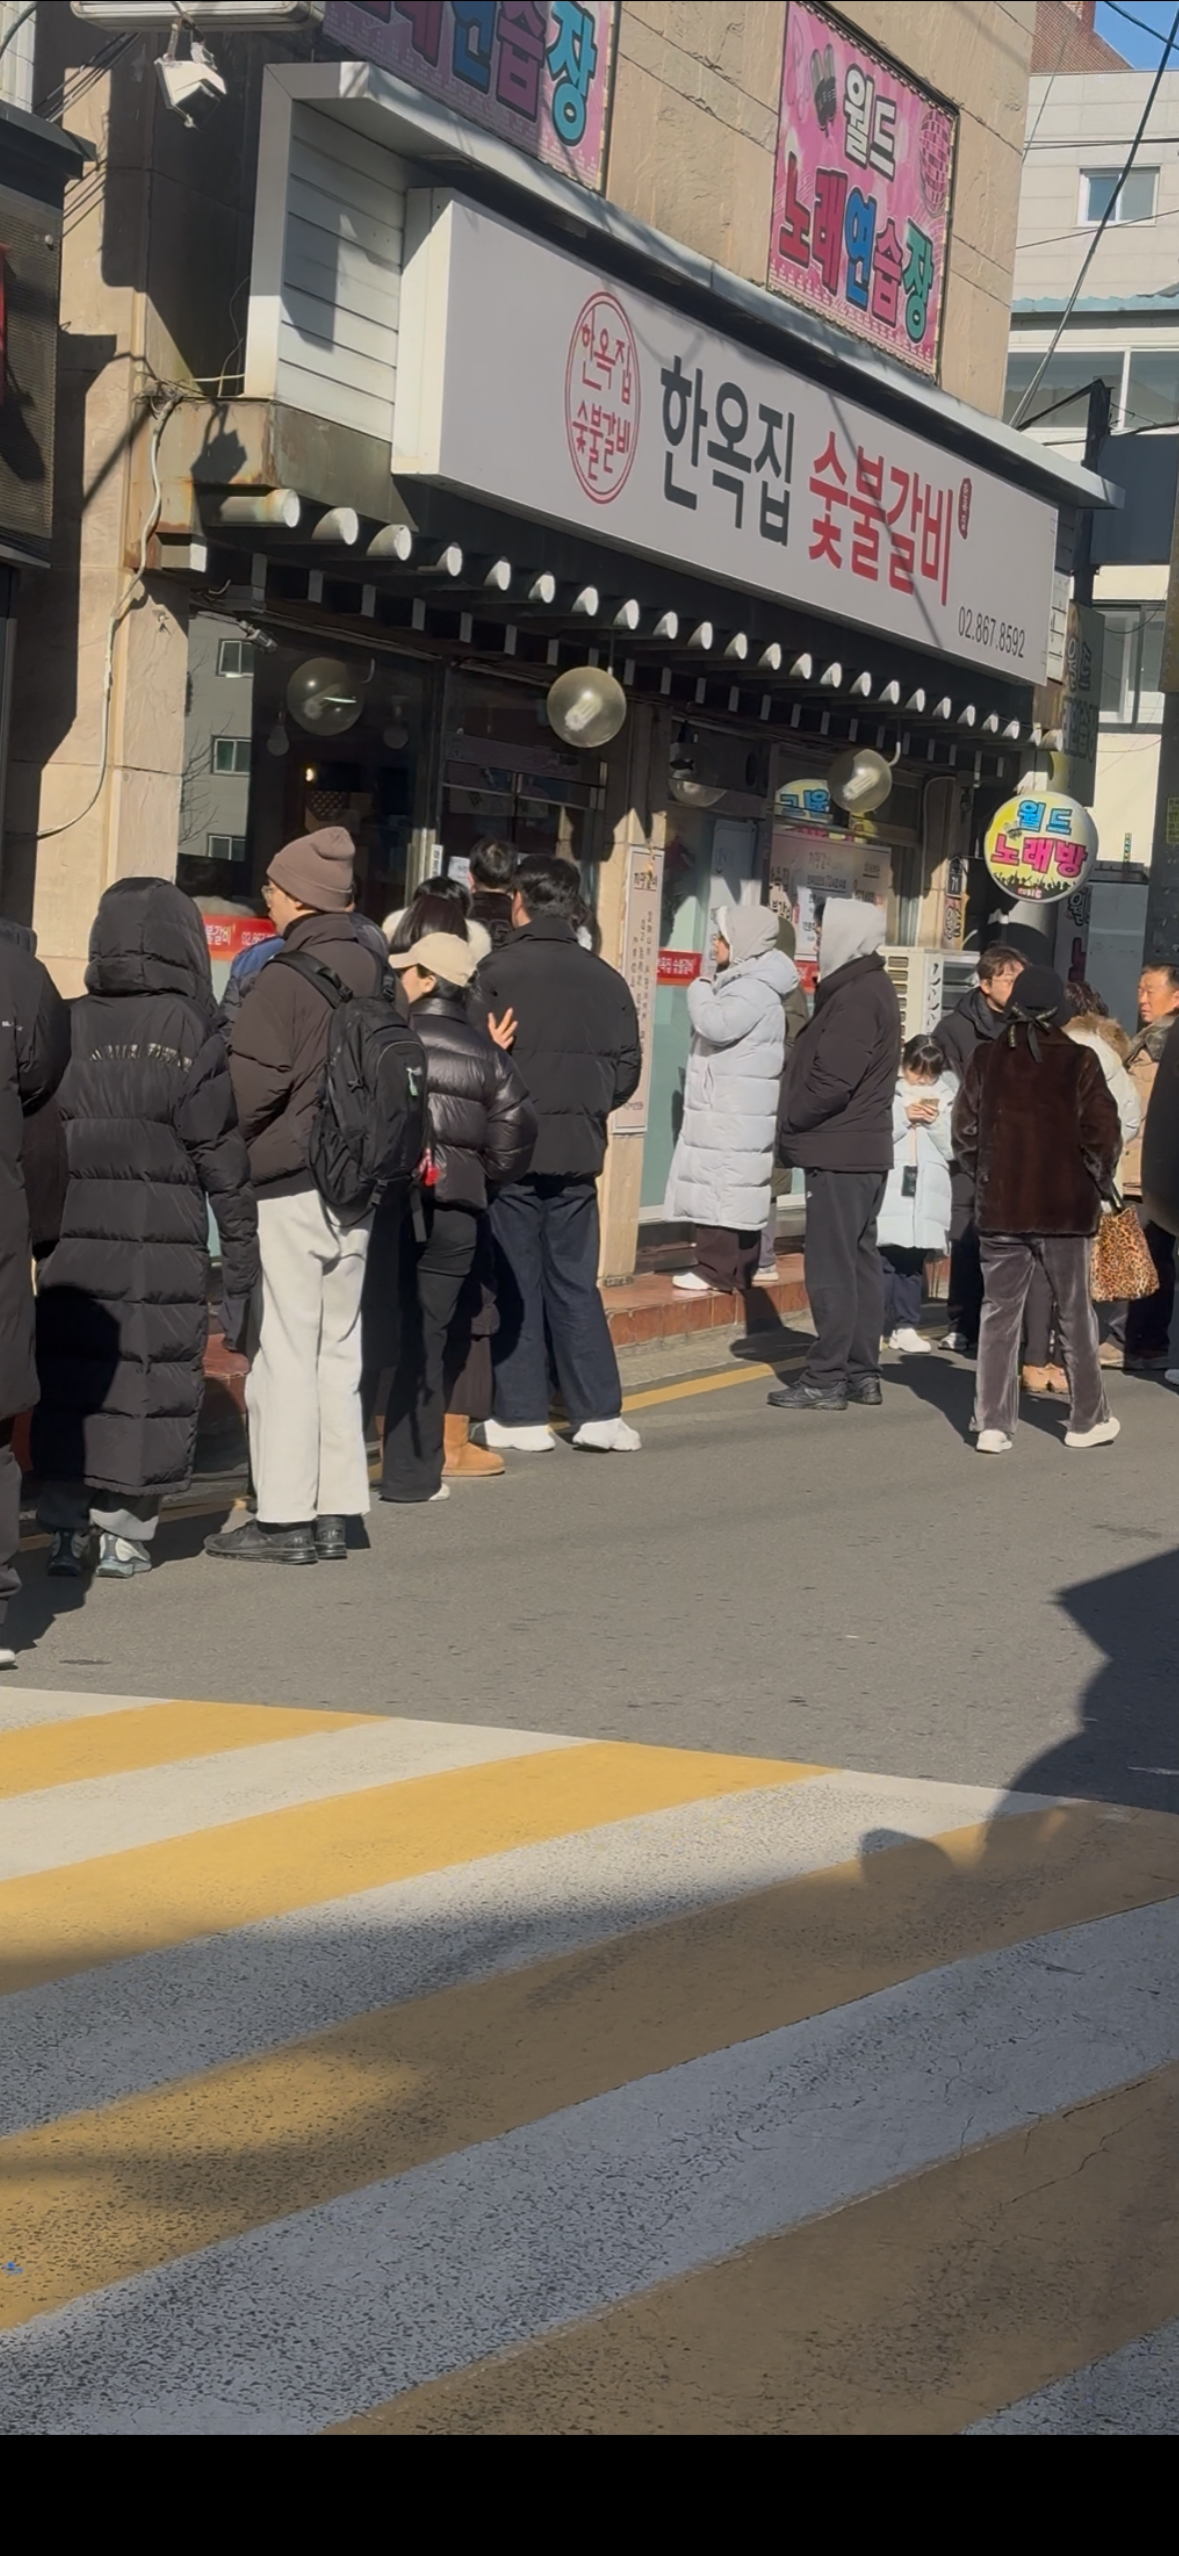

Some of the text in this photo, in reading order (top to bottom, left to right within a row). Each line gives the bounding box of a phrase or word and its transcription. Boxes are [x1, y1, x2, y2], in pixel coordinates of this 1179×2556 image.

[349, 1, 597, 147] 연습장
[843, 63, 897, 182] 월드
[778, 150, 934, 344] 노래연습장
[581, 307, 632, 405] 한옥집
[572, 400, 631, 481] 숯불갈비
[660, 354, 954, 606] 한옥집 숯불갈비
[957, 605, 1026, 659] 02.867.8592
[989, 833, 1089, 878] 노래방
[1017, 799, 1073, 836] 월드
